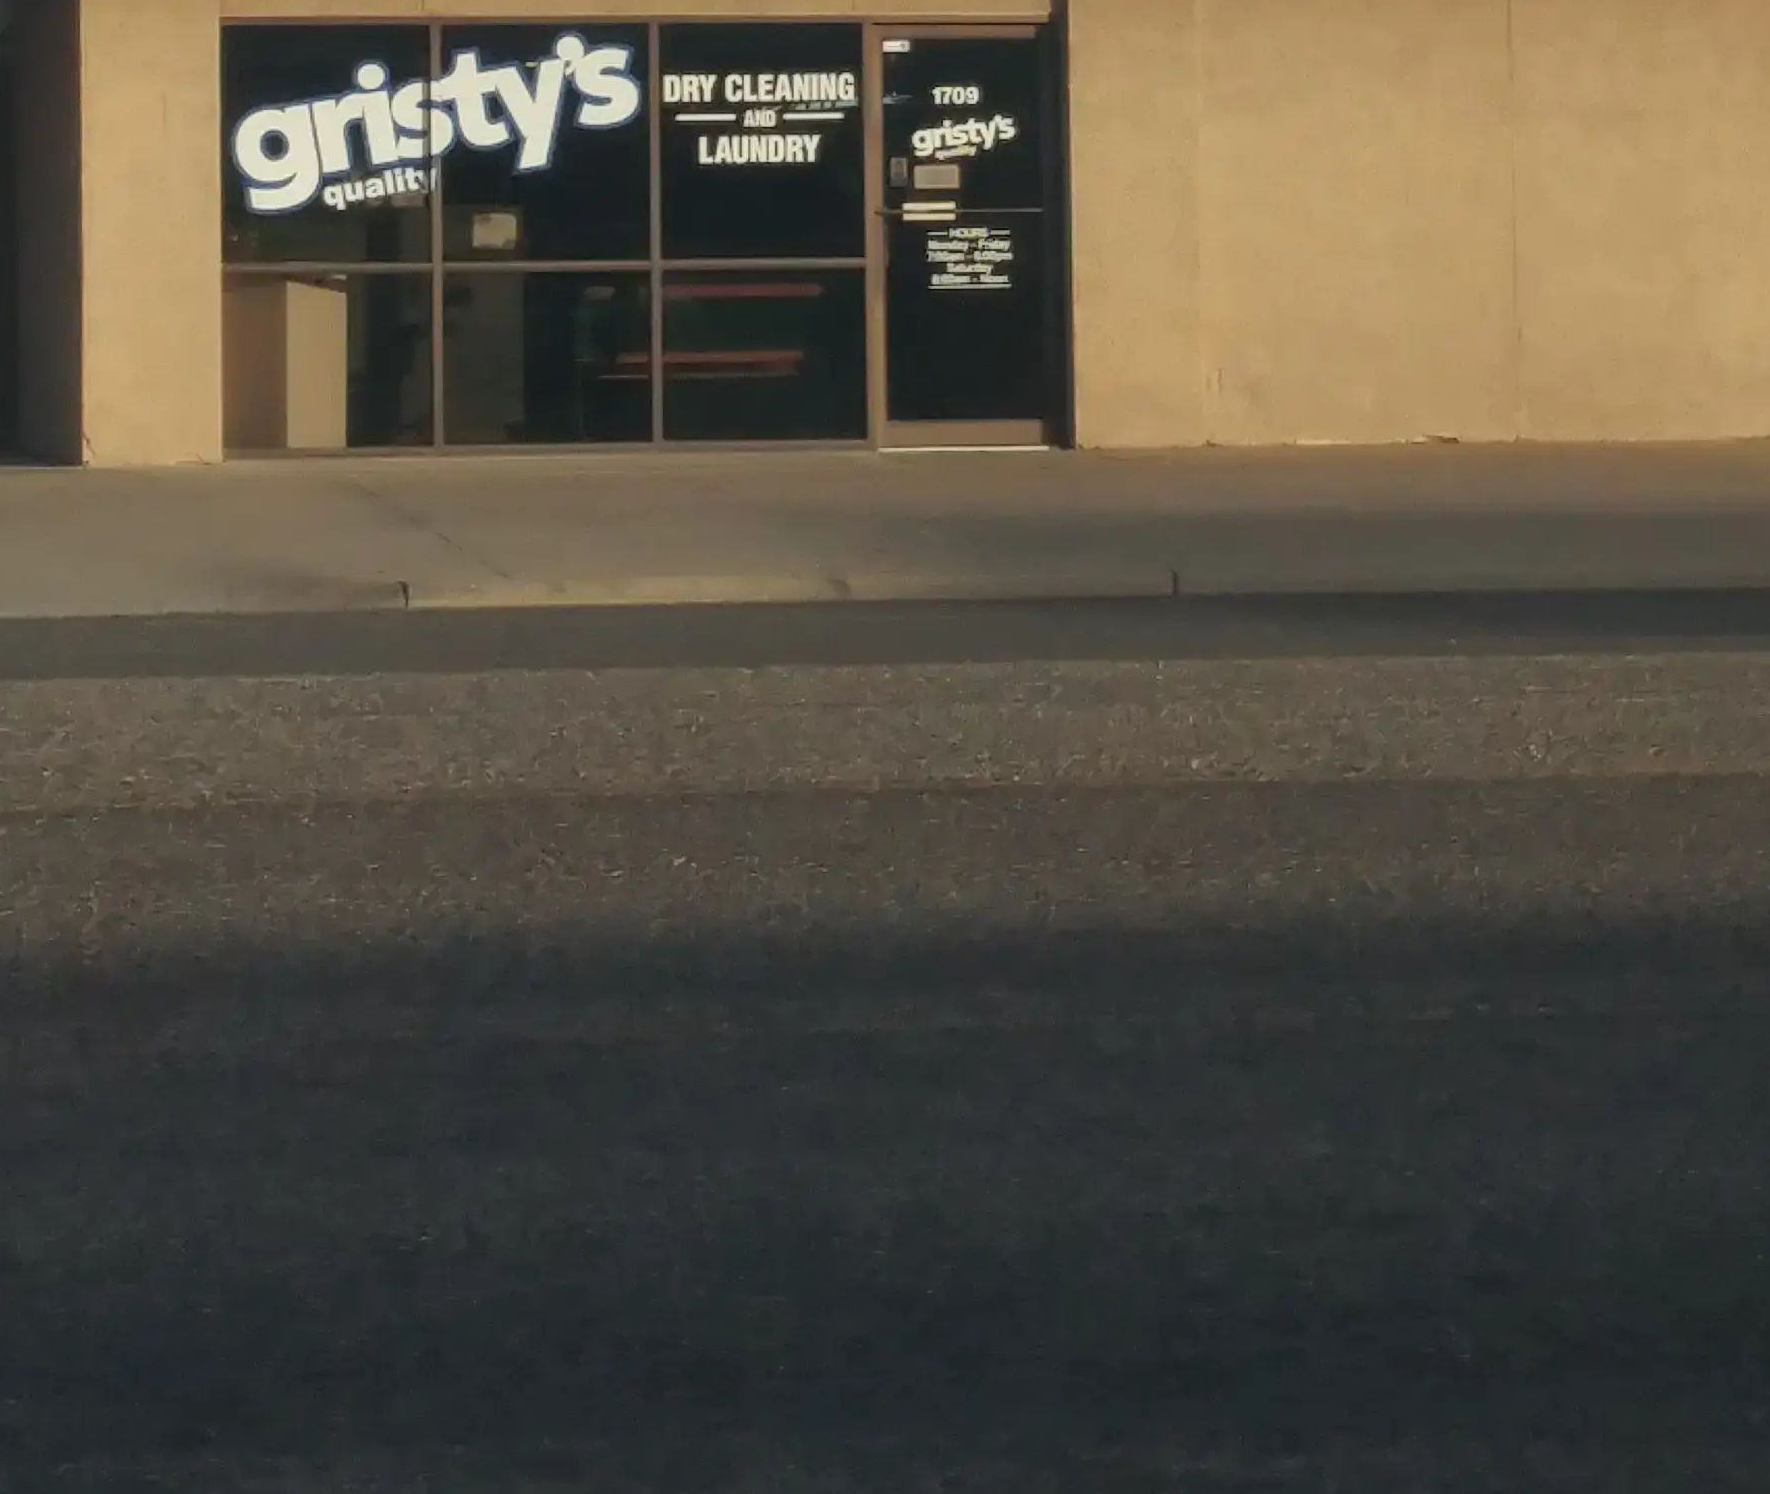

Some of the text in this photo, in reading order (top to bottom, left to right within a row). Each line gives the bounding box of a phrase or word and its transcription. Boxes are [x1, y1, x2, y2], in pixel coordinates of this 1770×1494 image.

[663, 72, 856, 103] DRY CLEANING
[932, 86, 980, 105] 1709
[232, 32, 641, 214] gristy's
[743, 108, 777, 128] AND
[698, 134, 821, 165] LAUNDRY
[912, 114, 1017, 157] gristy's
[323, 166, 438, 210] quality
